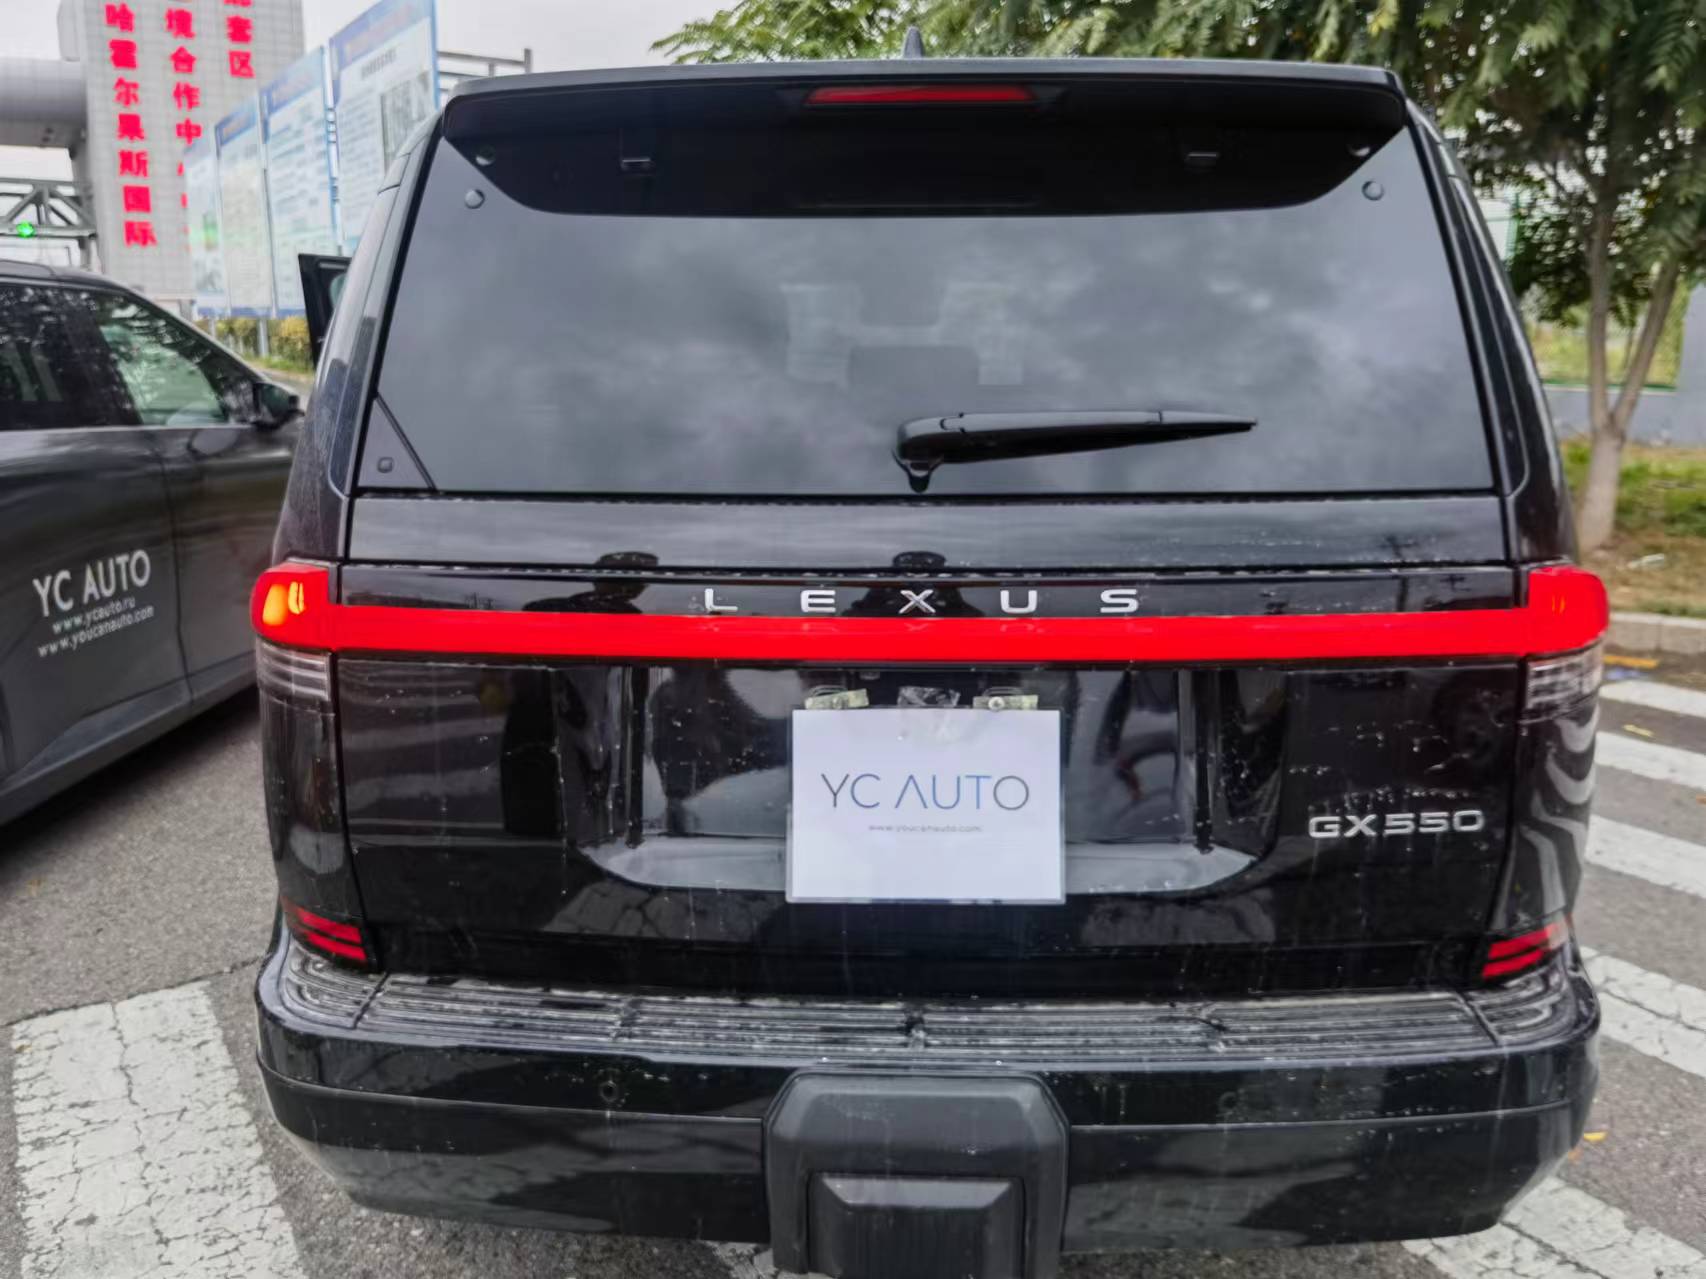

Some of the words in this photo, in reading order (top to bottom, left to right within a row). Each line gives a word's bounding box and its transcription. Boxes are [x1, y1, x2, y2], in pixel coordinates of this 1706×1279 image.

[223, 0, 256, 78] 套区
[32, 569, 74, 617] YC
[82, 549, 151, 604] AUTO
[703, 587, 1140, 614] LEXUS
[37, 605, 155, 657] www.youcanauto.com
[52, 596, 136, 634] www.ycauto.ru
[820, 773, 881, 809] YC
[894, 773, 1030, 811] AUTO
